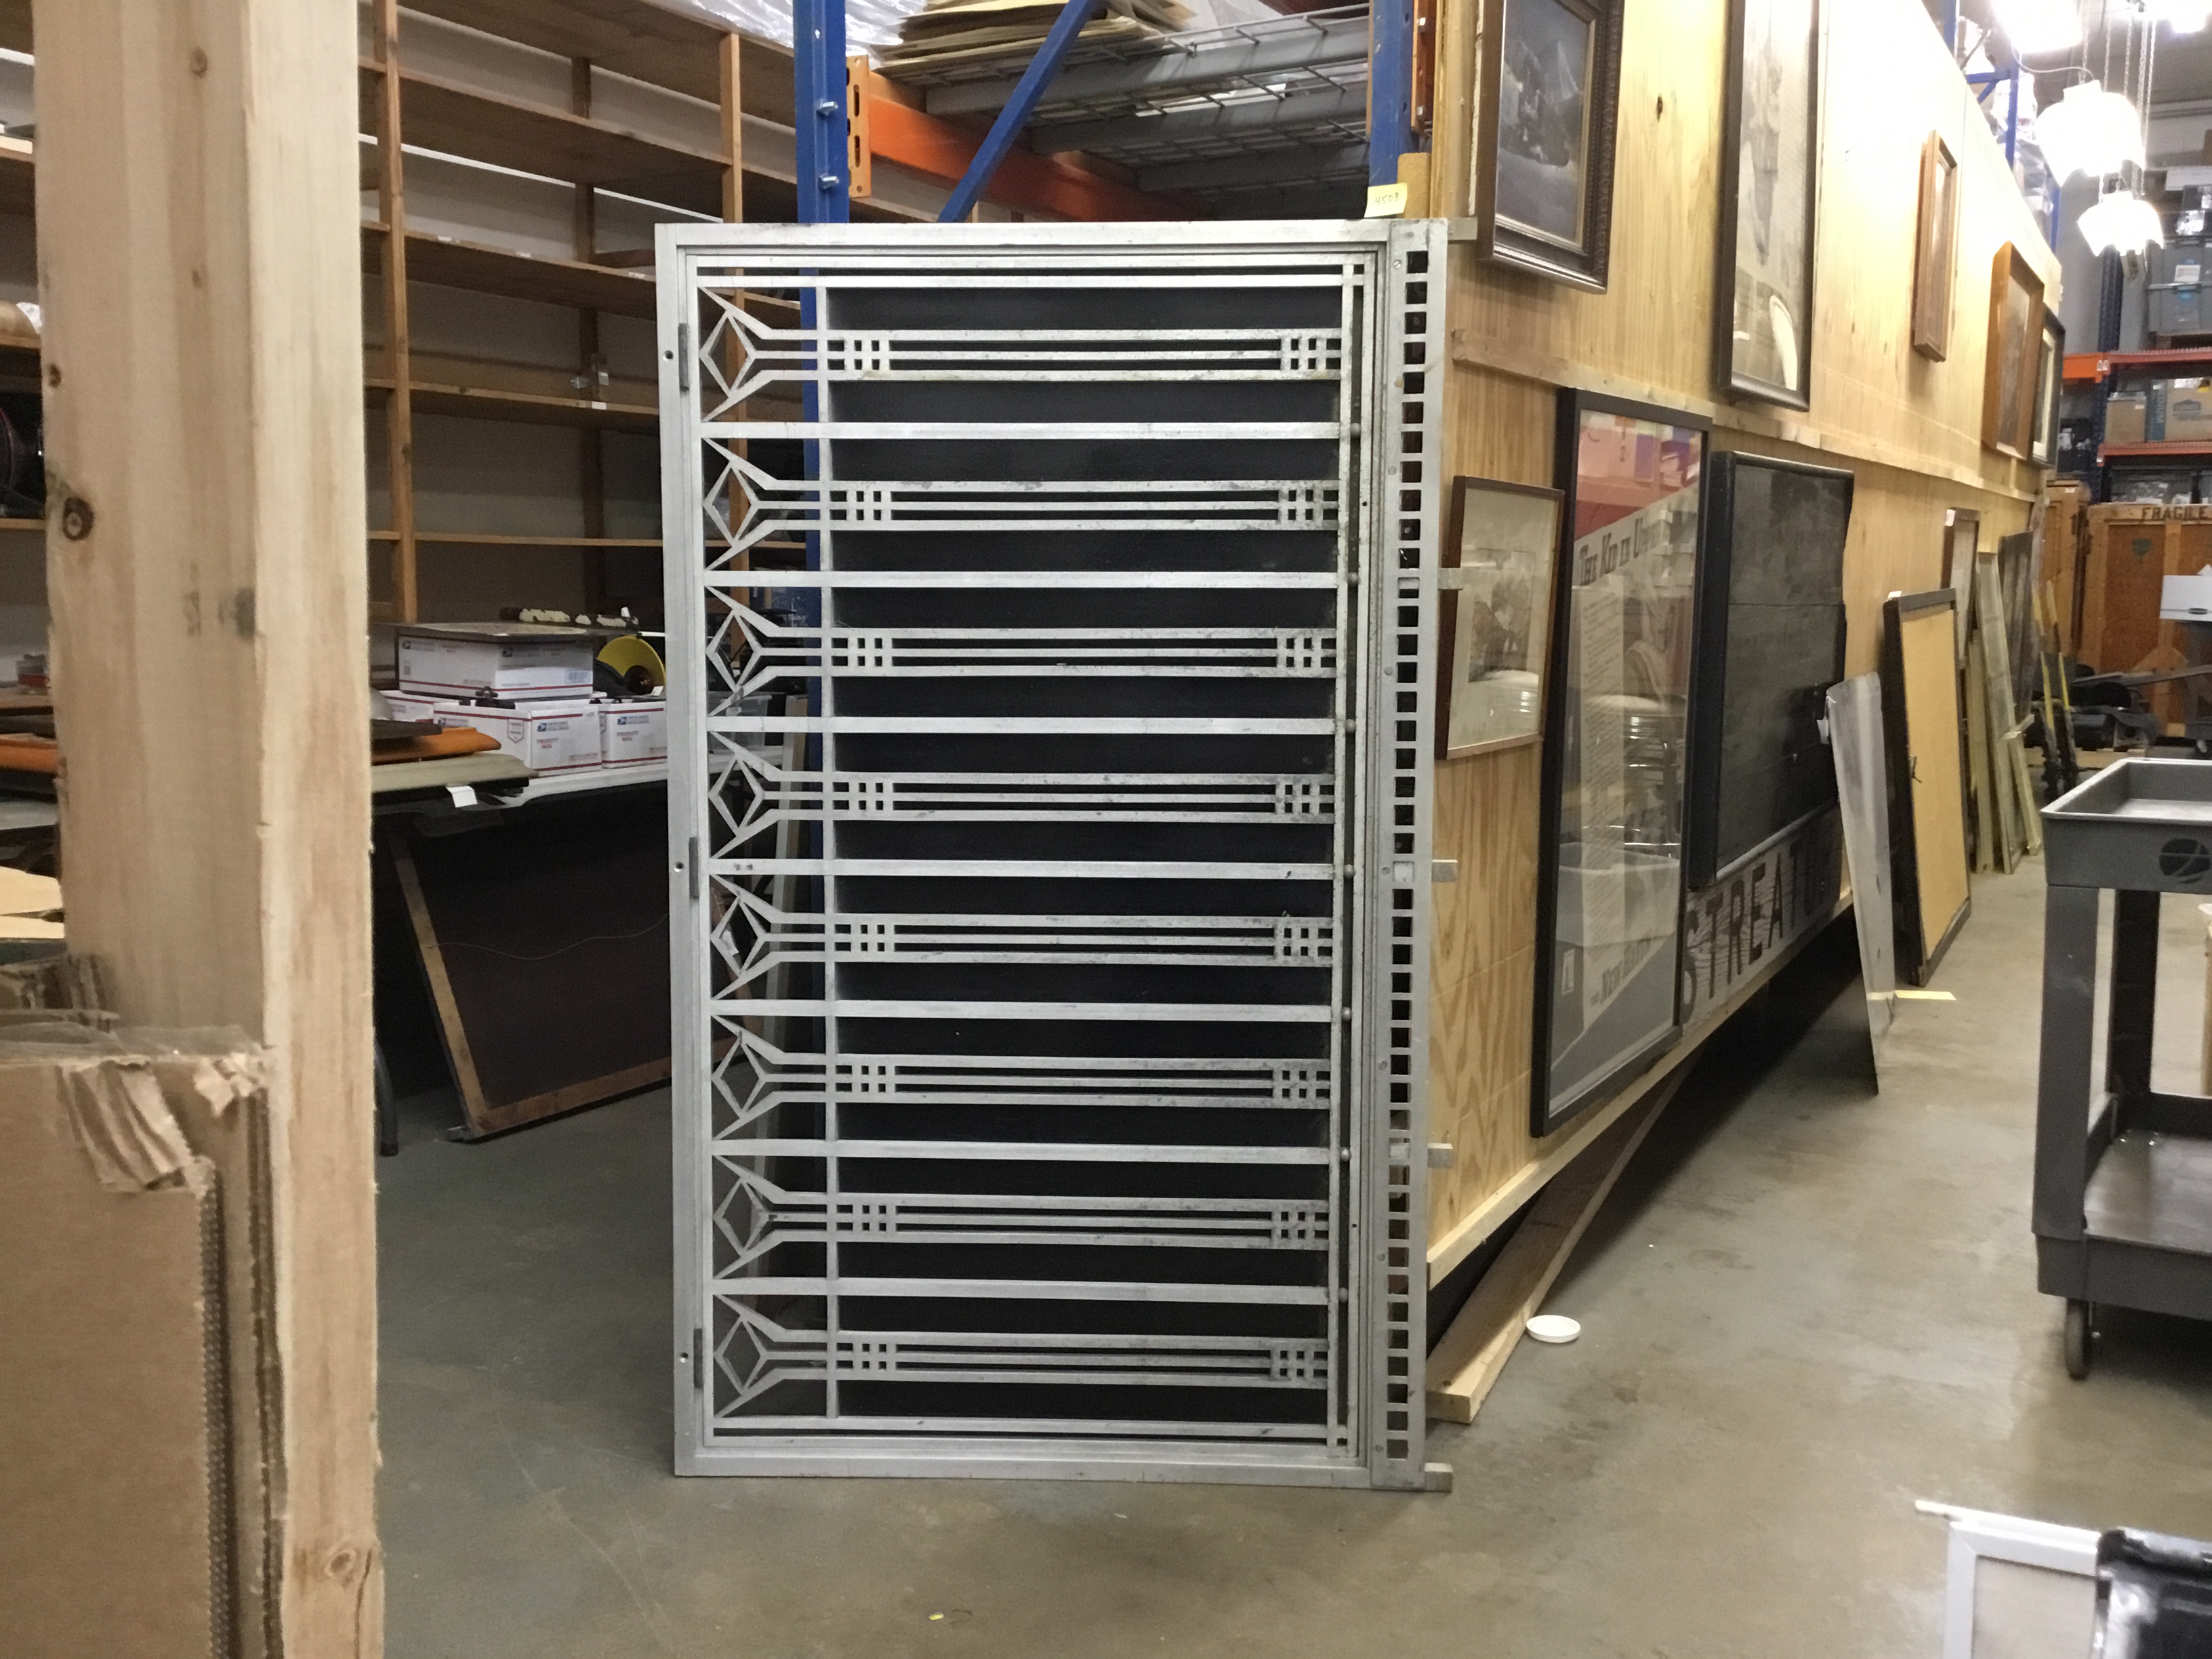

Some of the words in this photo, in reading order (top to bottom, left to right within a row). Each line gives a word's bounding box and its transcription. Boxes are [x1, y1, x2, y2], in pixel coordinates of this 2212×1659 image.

[1374, 192, 1400, 205] 4508
[2142, 506, 2209, 521] FRAGILE
[1579, 544, 1598, 586] THE
[1599, 532, 1618, 577] KID
